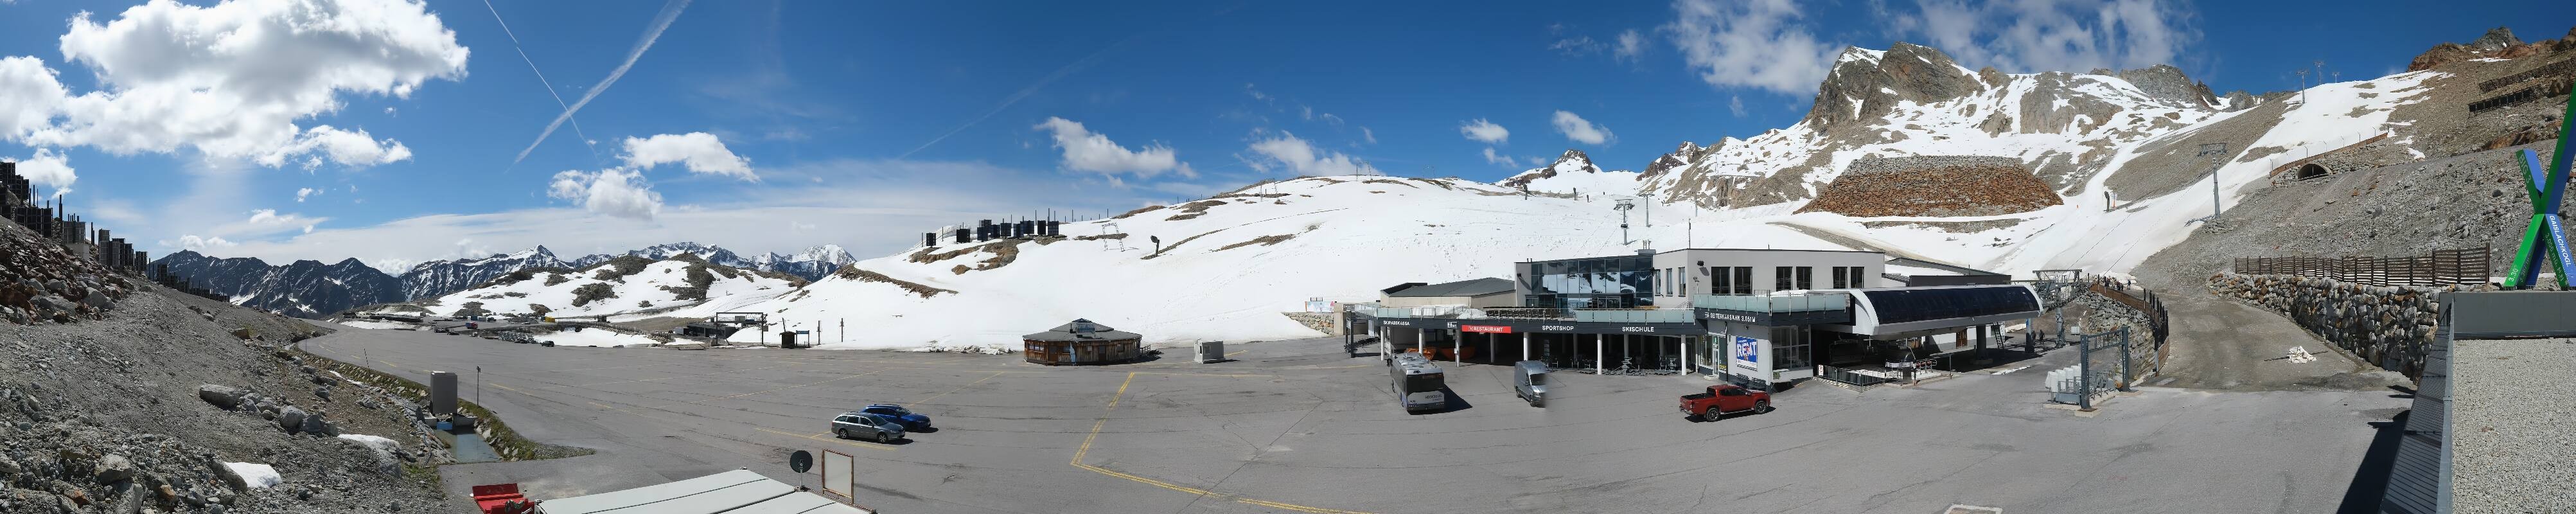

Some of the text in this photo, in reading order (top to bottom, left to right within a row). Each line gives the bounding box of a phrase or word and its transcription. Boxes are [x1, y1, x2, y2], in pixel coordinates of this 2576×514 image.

[2519, 154, 2532, 184] BIG 3
[2549, 215, 2571, 267] GAISLACHKOGL
[1737, 341, 1757, 357] RENT
